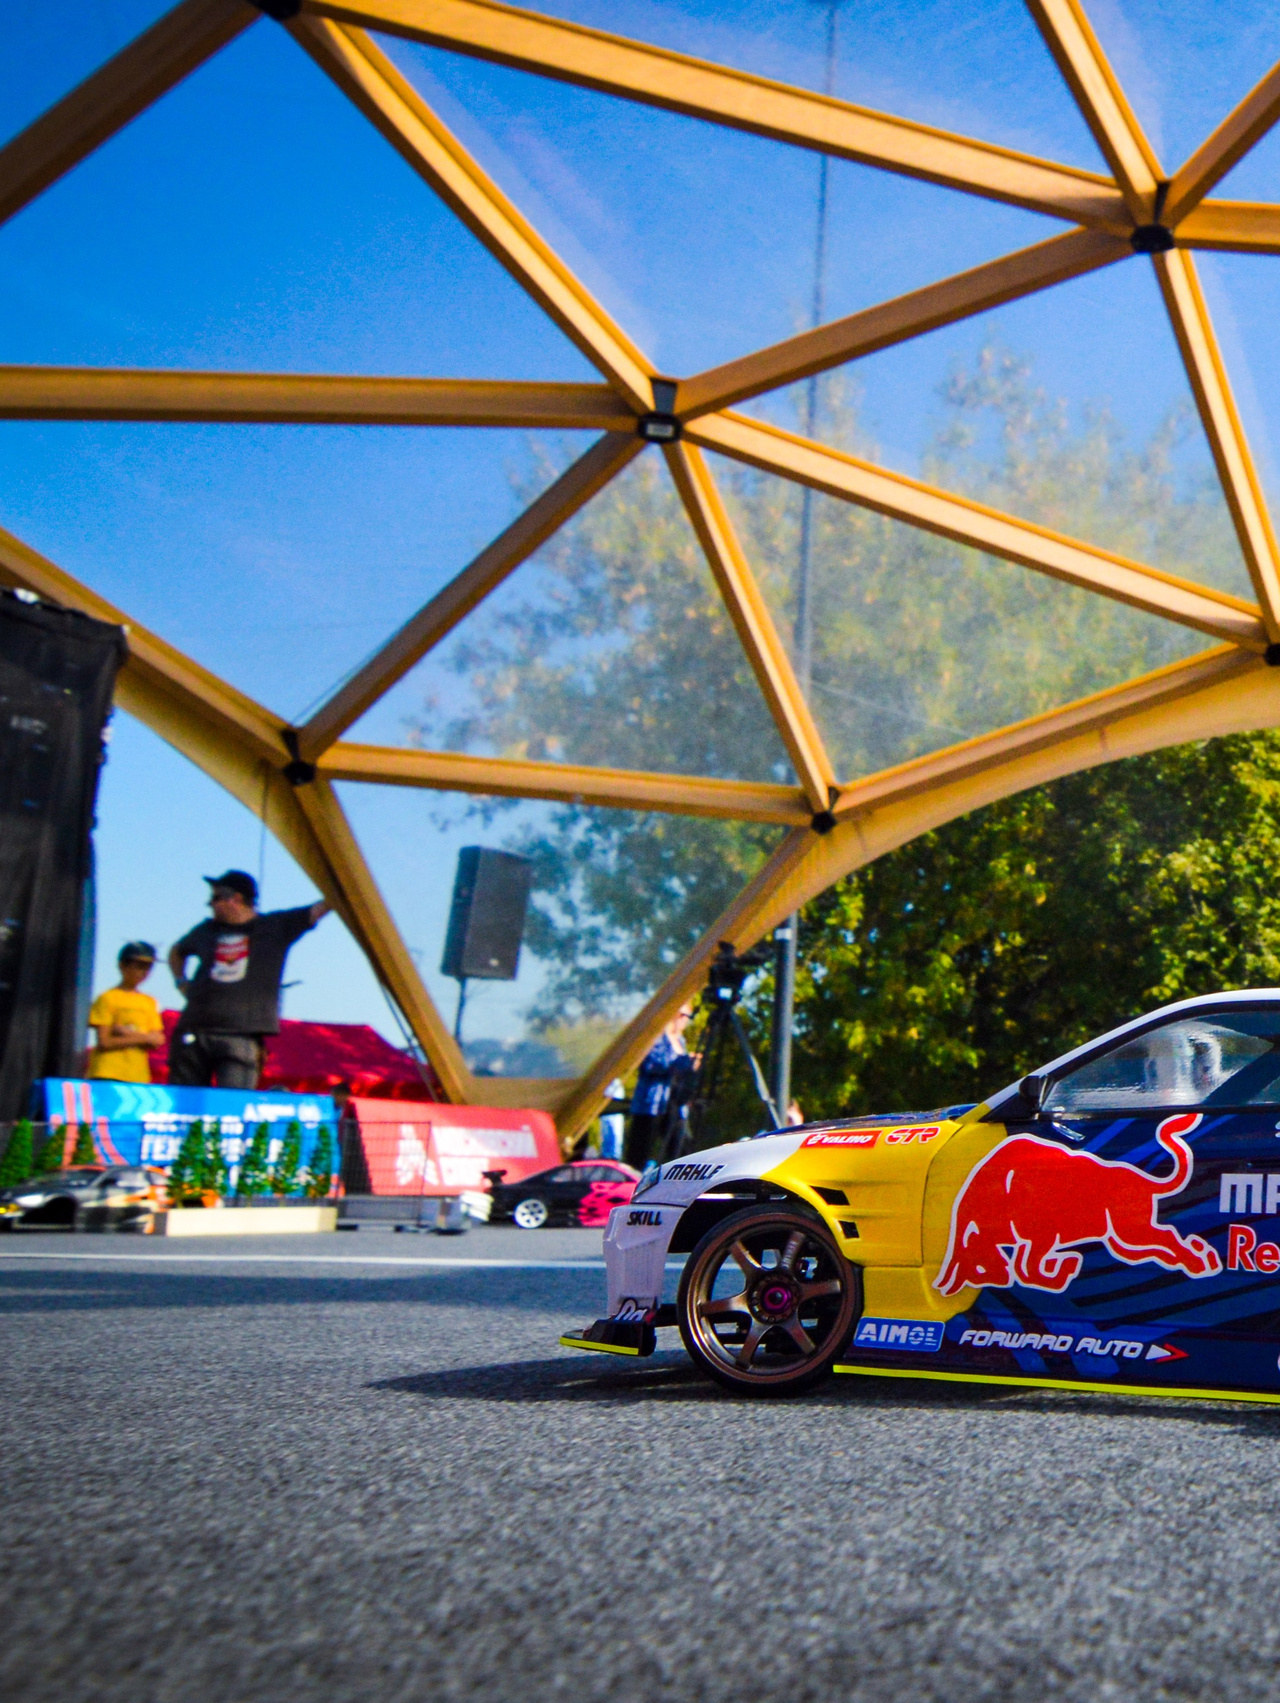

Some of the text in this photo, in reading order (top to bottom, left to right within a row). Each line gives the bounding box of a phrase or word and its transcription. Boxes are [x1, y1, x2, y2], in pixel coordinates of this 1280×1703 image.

[821, 1134, 873, 1144] VALINO
[627, 1211, 662, 1226] SKILL
[858, 1323, 937, 1346] AIMOL
[959, 1330, 1144, 1358] FORWARD AUTO
